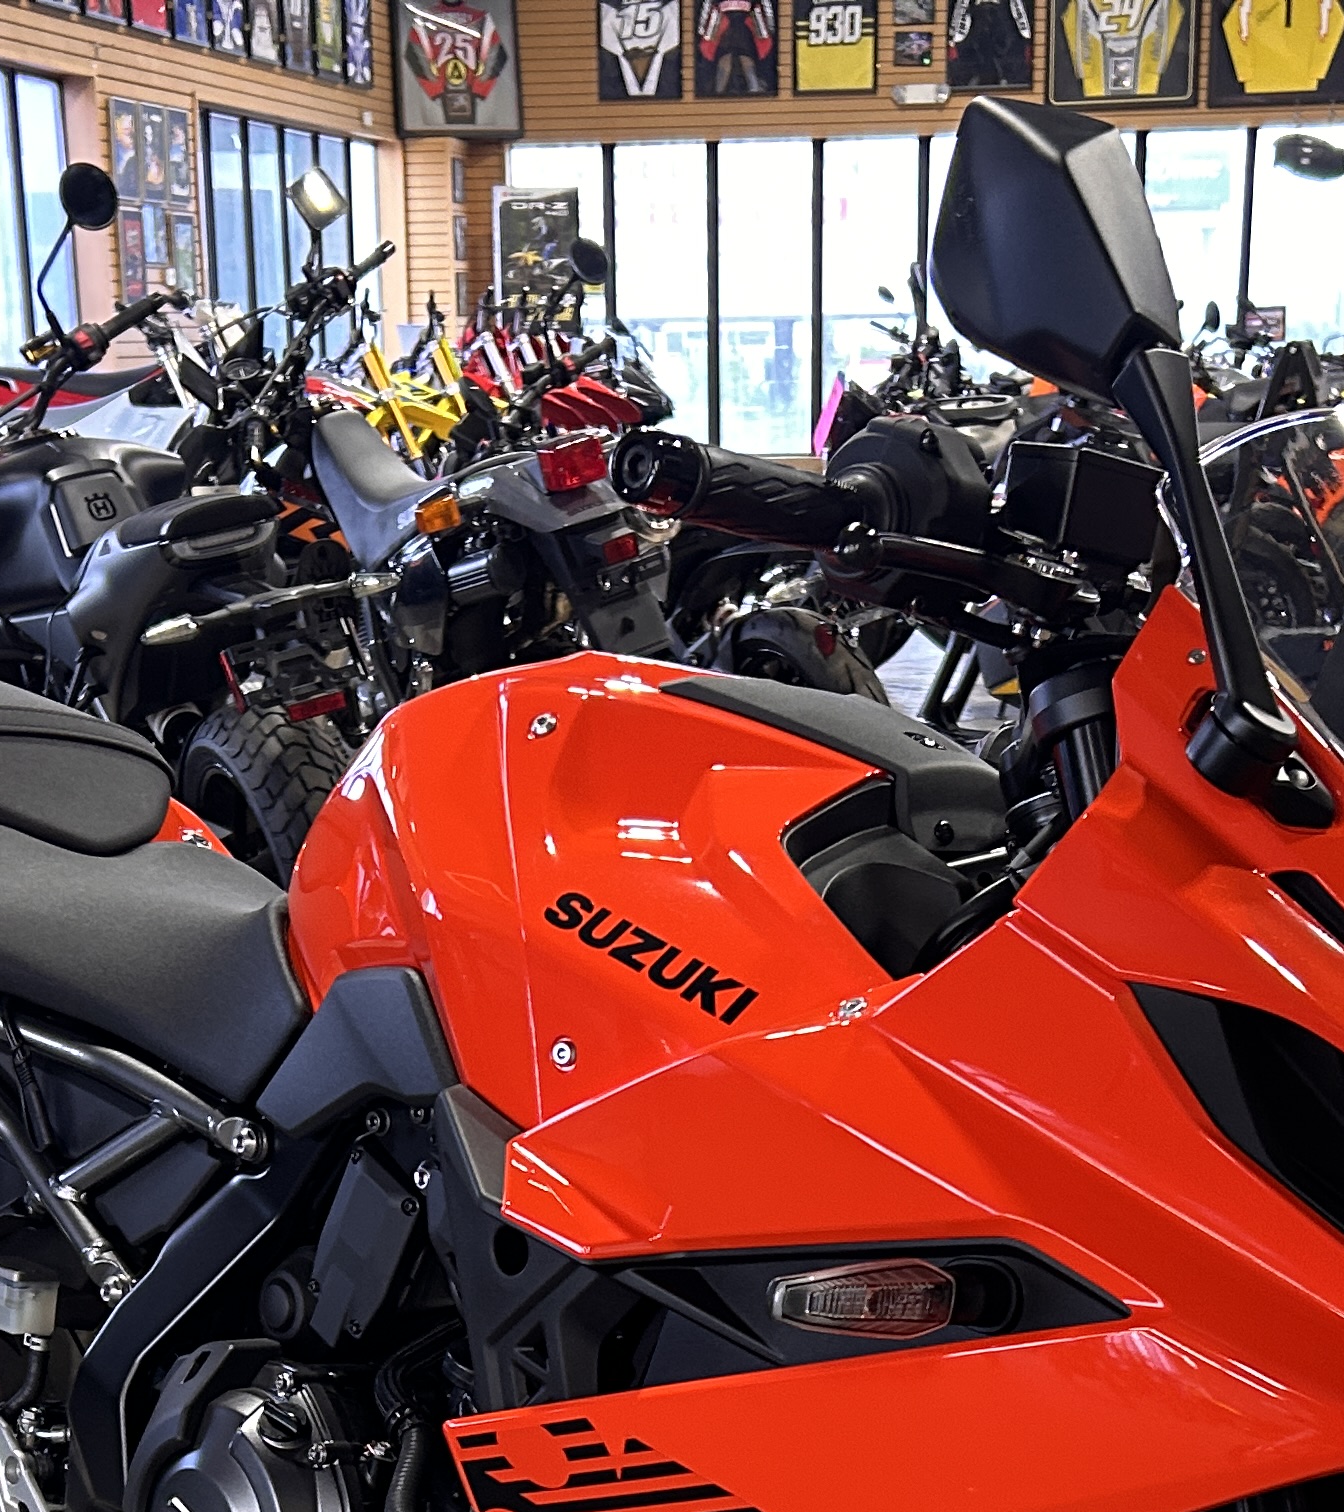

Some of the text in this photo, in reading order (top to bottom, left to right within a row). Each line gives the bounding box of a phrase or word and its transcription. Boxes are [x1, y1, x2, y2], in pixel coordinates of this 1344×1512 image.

[616, 5, 664, 39] 15
[809, 5, 863, 45] 930
[433, 31, 477, 71] 25
[544, 892, 759, 1025] SUZUKI
